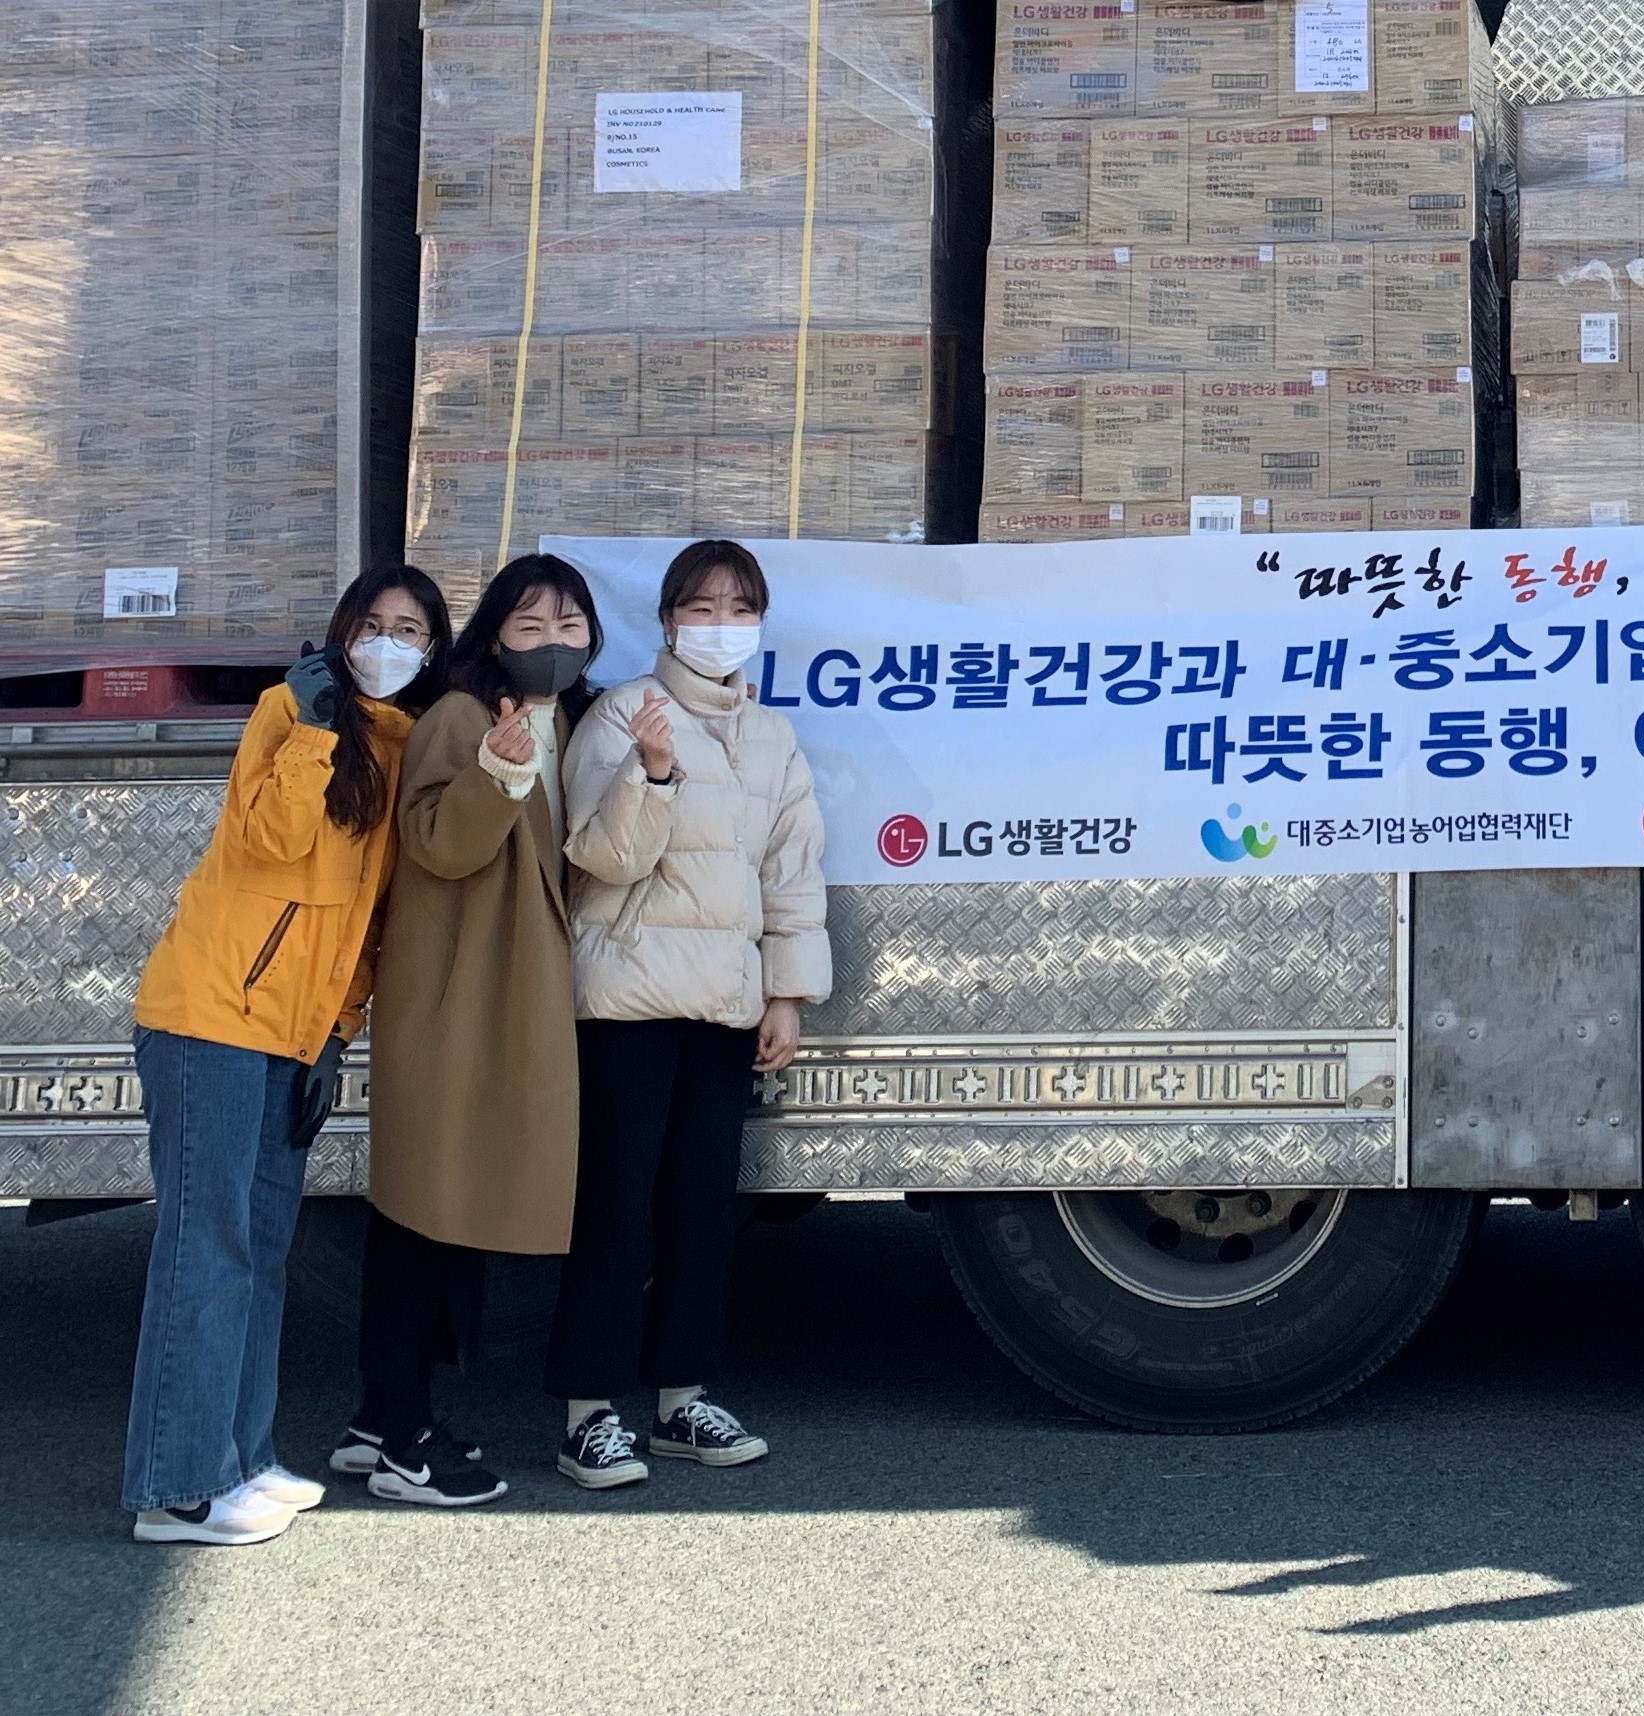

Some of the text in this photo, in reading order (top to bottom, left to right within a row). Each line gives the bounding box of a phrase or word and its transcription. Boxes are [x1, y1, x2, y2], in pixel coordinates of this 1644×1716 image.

[1350, 126, 1424, 141] LG생활건강
[606, 160, 649, 168] COSMETICS
[1202, 381, 1278, 396] LG생활건강
[1504, 546, 1629, 603] 동행,
[758, 639, 1246, 712] LG생활건강과
[1163, 709, 1392, 785] 따뜻한
[1420, 706, 1597, 779] 동행,
